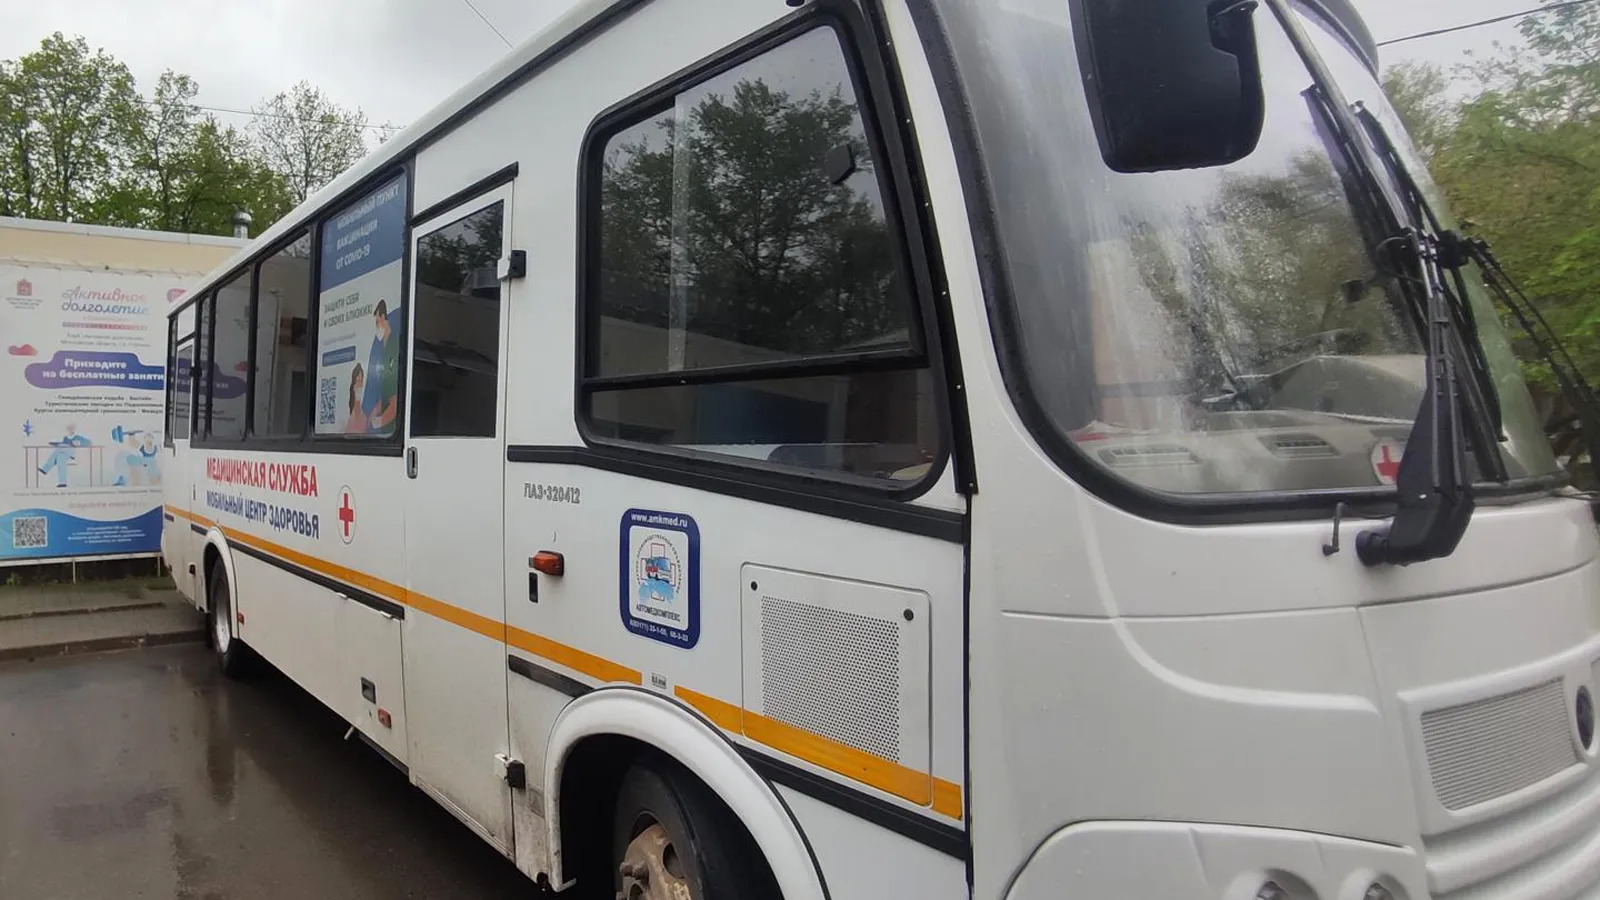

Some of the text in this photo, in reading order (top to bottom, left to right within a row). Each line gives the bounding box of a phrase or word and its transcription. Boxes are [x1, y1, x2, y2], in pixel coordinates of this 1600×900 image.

[62, 285, 147, 302] Активное
[62, 300, 149, 315] долголетие
[64, 358, 127, 370] Приходите
[42, 370, 164, 381] на бесплатные заняти
[206, 456, 319, 497] МЕДИЦИНСКАЯ СЛУЖБА
[206, 489, 320, 540] МОБИЛЬНЫЙ ЦЕНТР ЗДОРОВЬЯ
[630, 513, 688, 528] www.amkmed.ru
